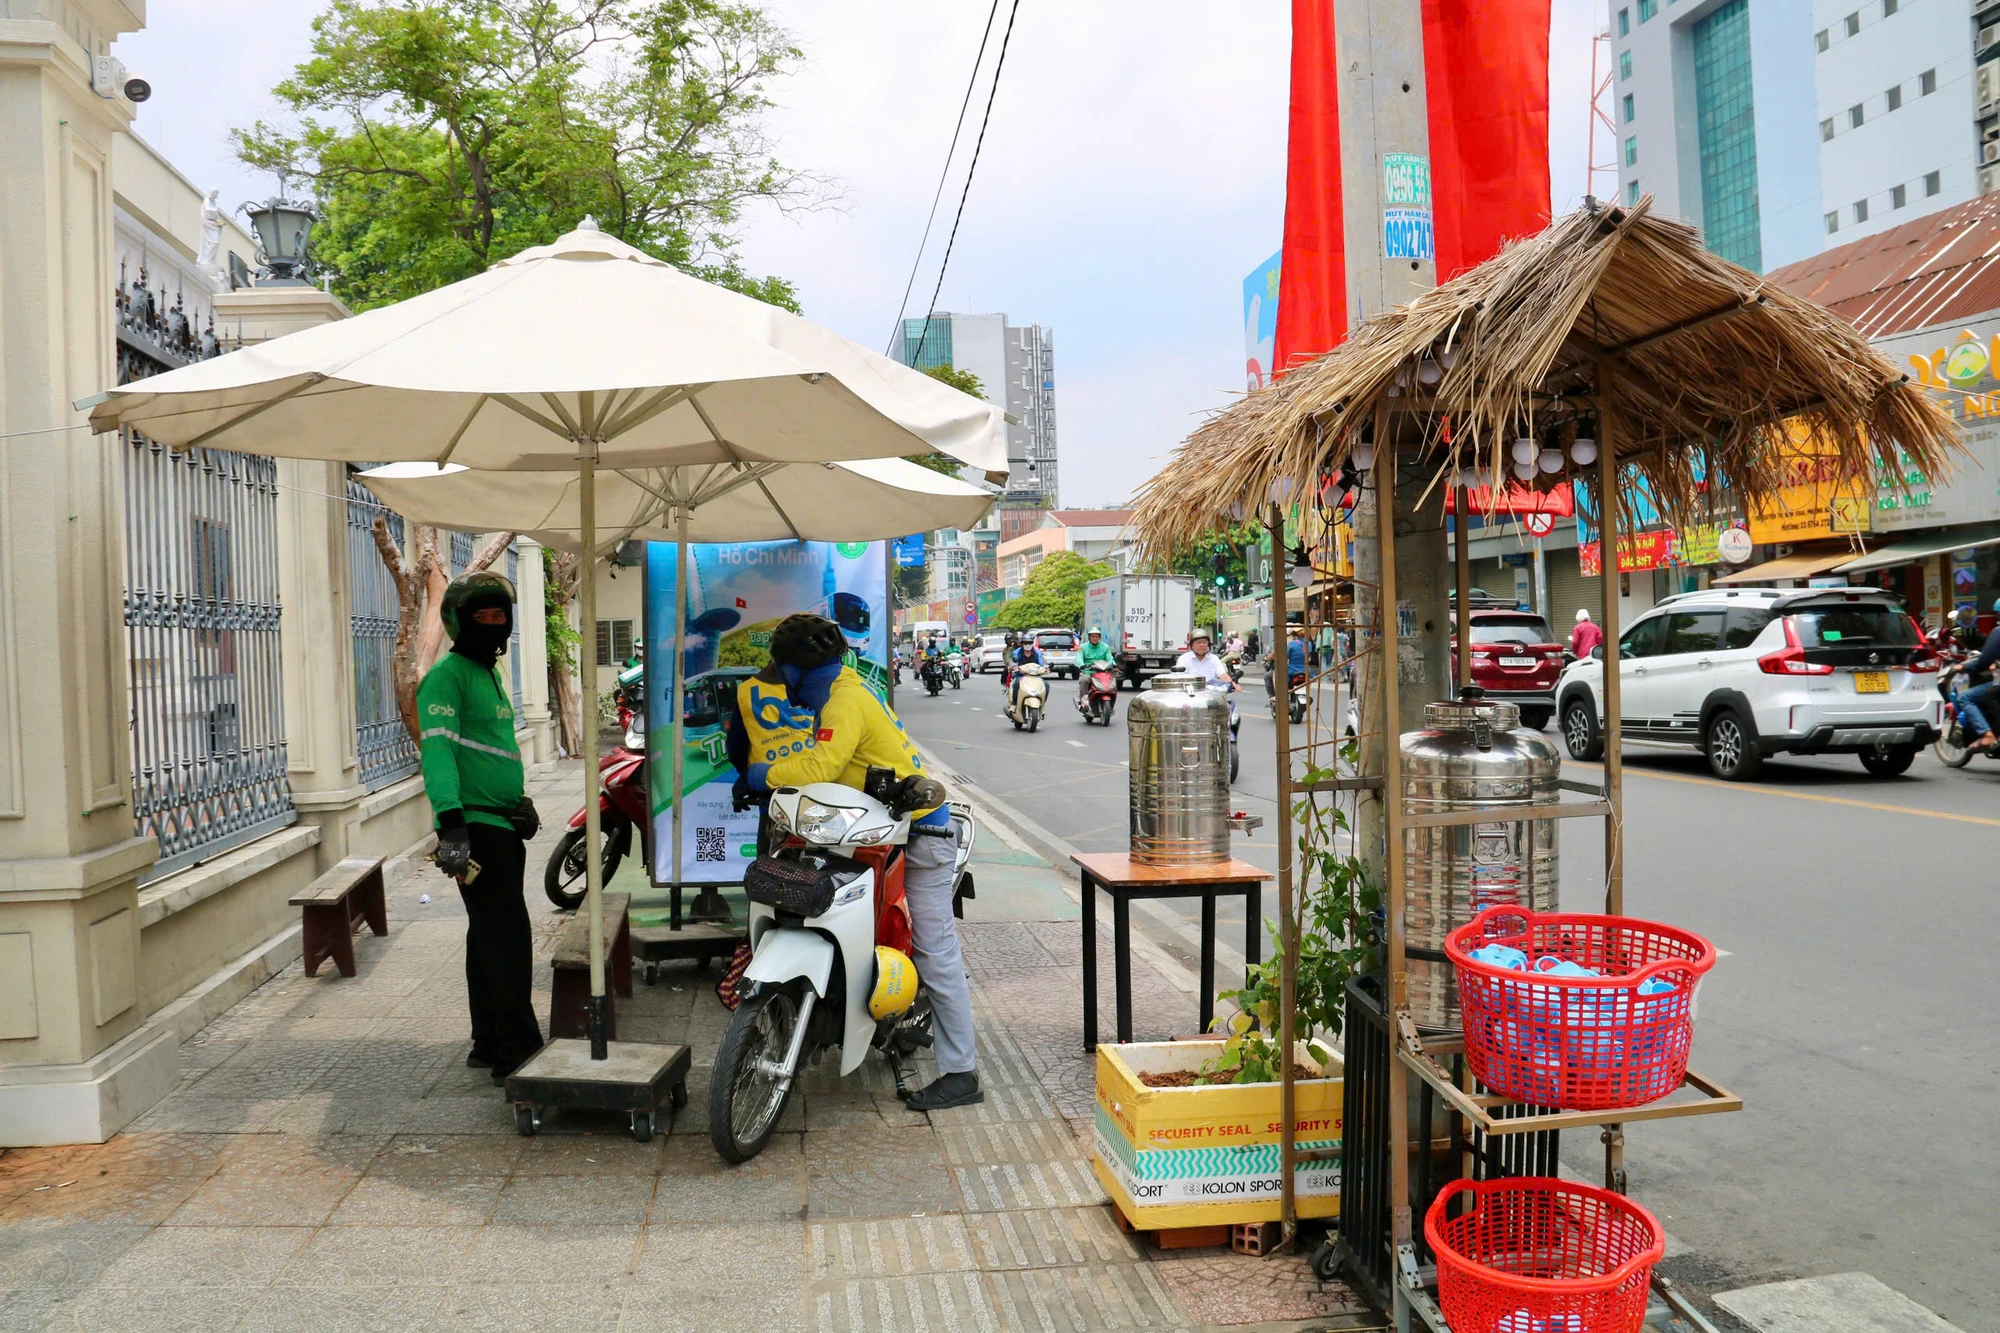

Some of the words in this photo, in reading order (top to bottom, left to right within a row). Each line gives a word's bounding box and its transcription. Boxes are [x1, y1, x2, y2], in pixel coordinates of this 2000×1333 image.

[1131, 607, 1145, 615] 51D
[1125, 615, 1139, 623] 927
[1141, 615, 1151, 623] 27
[427, 703, 456, 717] Grab
[495, 704, 513, 720] Grab
[1148, 1126, 1214, 1140] SECURITY
[1218, 1124, 1252, 1136] SEAL
[1202, 1181, 1245, 1194] KOLON
